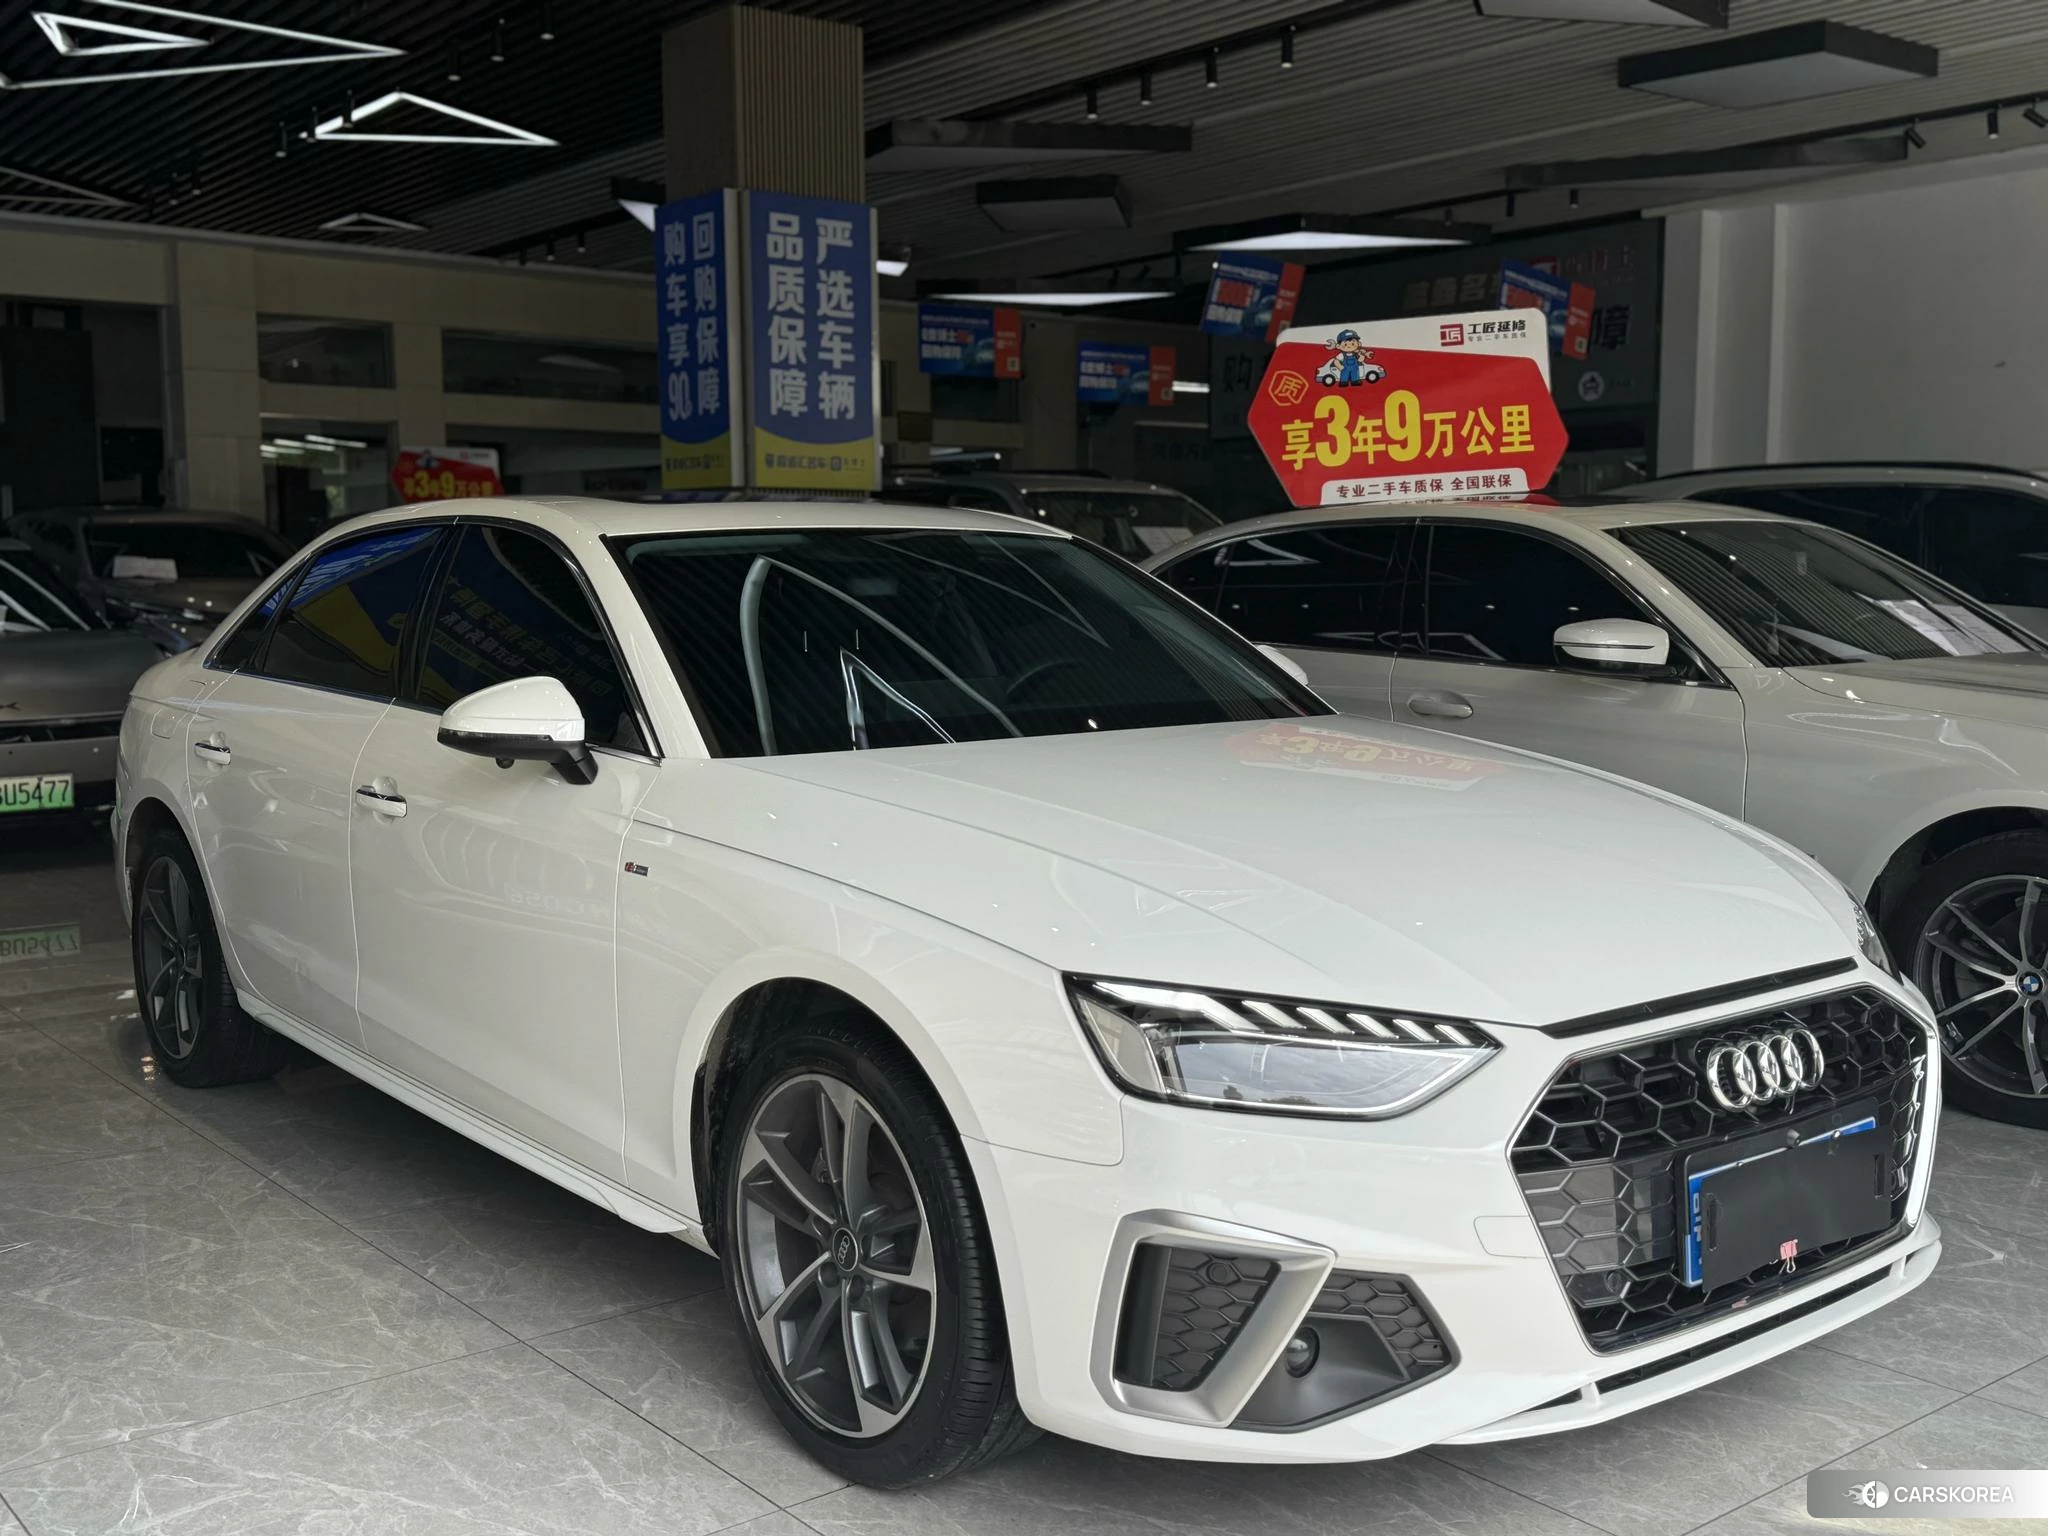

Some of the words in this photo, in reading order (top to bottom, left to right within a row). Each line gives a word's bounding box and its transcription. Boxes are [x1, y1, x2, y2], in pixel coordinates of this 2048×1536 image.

[692, 211, 720, 416] 回购保障
[766, 211, 808, 417] 品质保障
[815, 217, 856, 420] 严选车辆
[1467, 319, 1526, 335] 工匠延修
[1281, 389, 1535, 471] 享3年9万公里
[1335, 477, 1444, 499] 专业二手车质保
[1452, 473, 1513, 491] 全国联保
[0, 779, 70, 807] U5477
